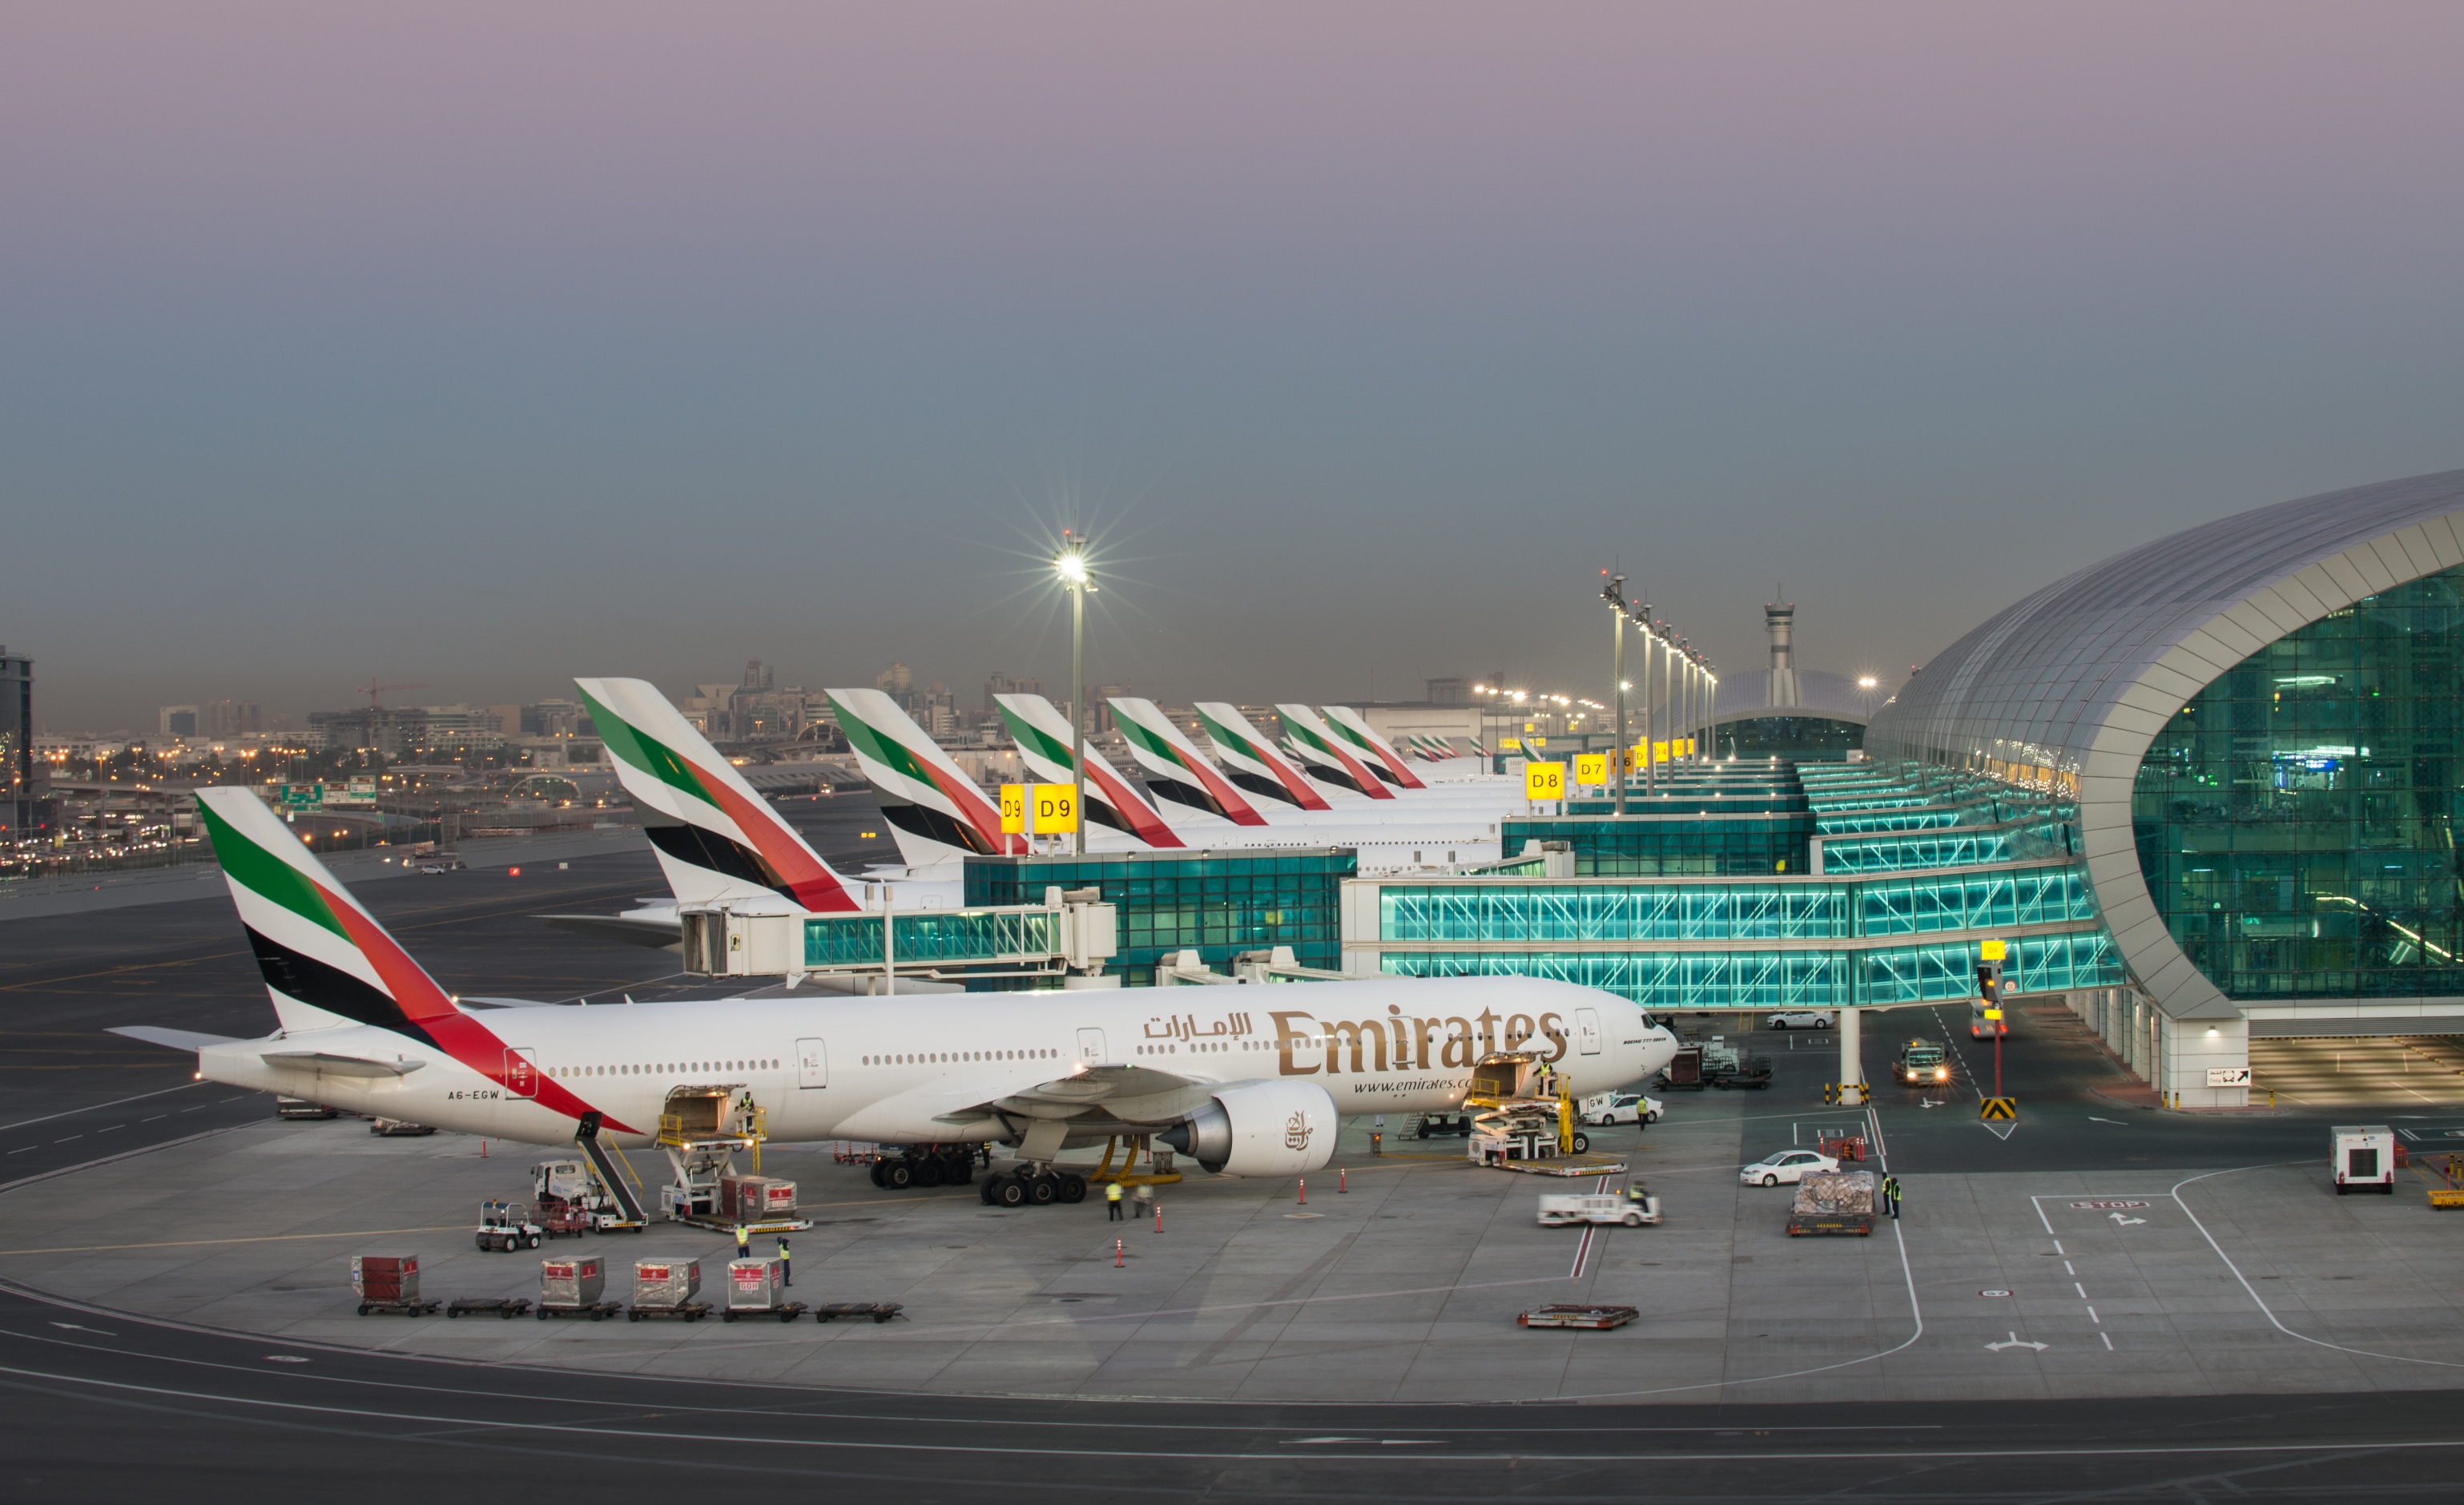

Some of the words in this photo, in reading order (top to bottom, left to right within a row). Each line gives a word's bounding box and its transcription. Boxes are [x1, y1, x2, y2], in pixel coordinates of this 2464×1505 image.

[1581, 763, 1602, 775] D7
[1532, 774, 1558, 787] D8
[1005, 799, 1021, 818] D9
[1041, 799, 1070, 818] D9
[1143, 1012, 1253, 1043] الإمارات
[1267, 1004, 1568, 1076] Emirates
[1355, 1077, 1473, 1093] www.emirates.co
[448, 1090, 499, 1100] A6-EGW
[2079, 1201, 2138, 1209] STOP
